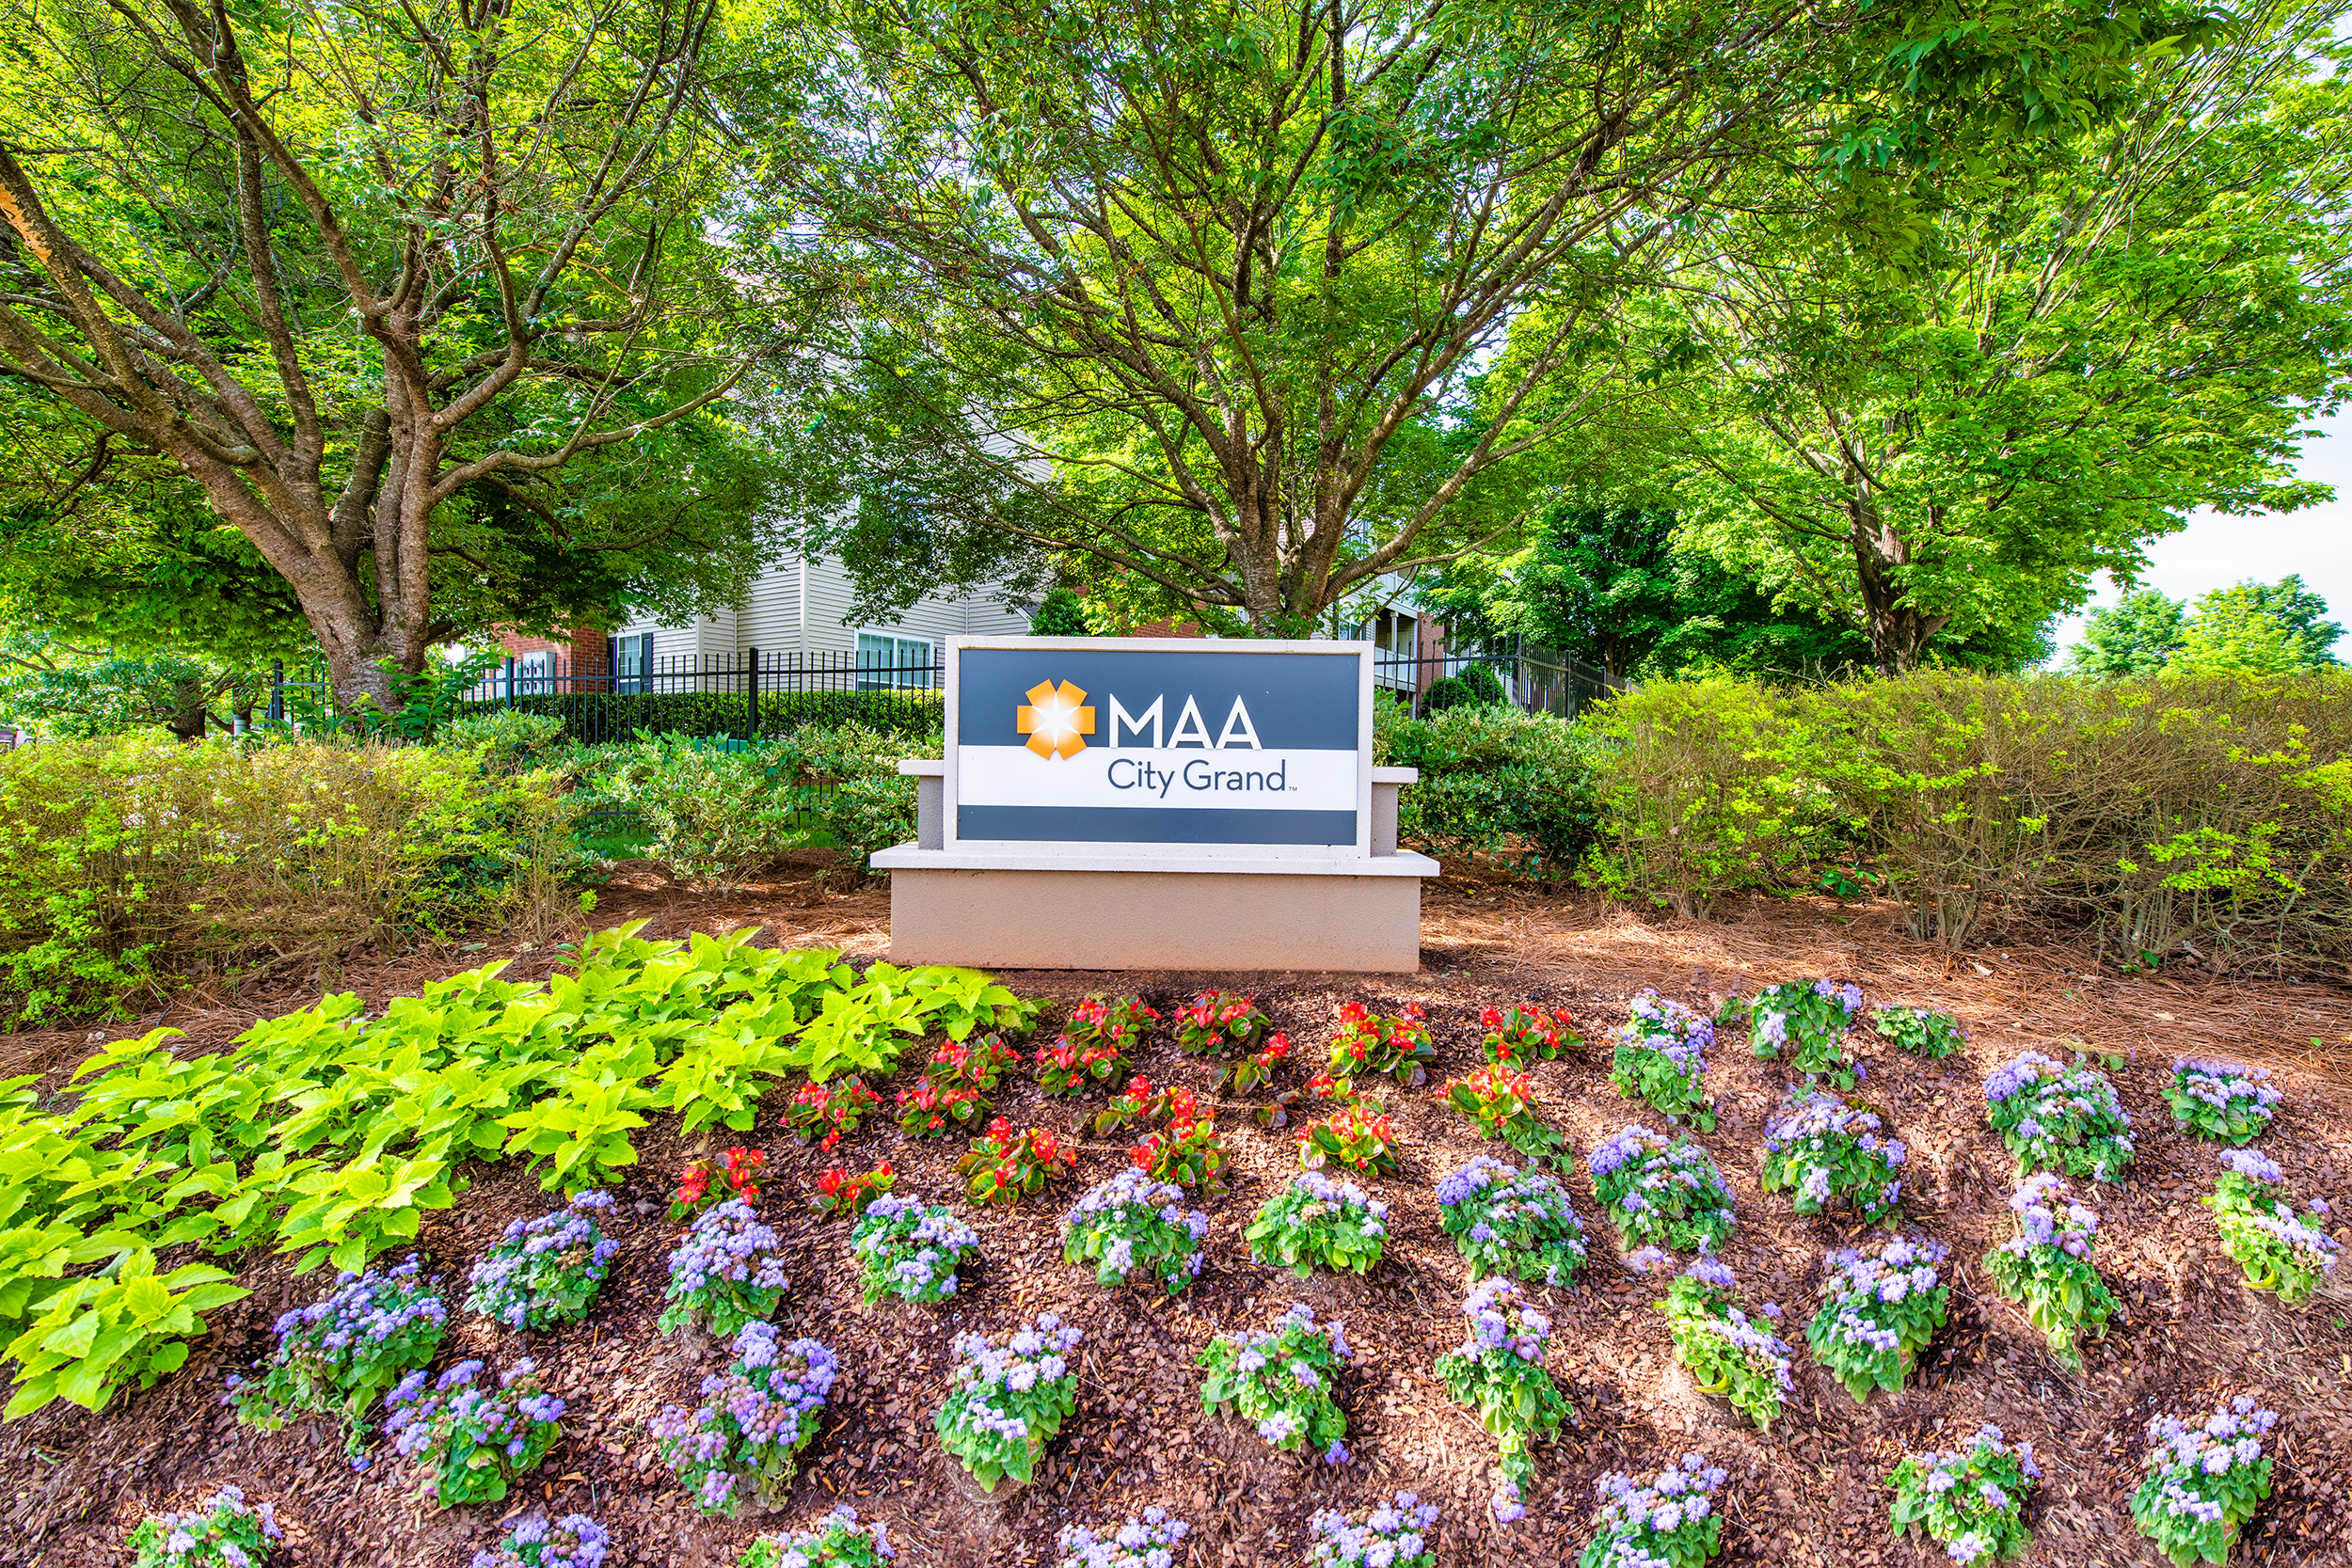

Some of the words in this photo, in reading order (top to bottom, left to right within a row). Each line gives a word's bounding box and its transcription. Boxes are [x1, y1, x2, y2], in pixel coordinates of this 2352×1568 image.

[1108, 692, 1263, 751] MAA
[1107, 758, 1176, 800] City
[1183, 758, 1286, 792] Grand
